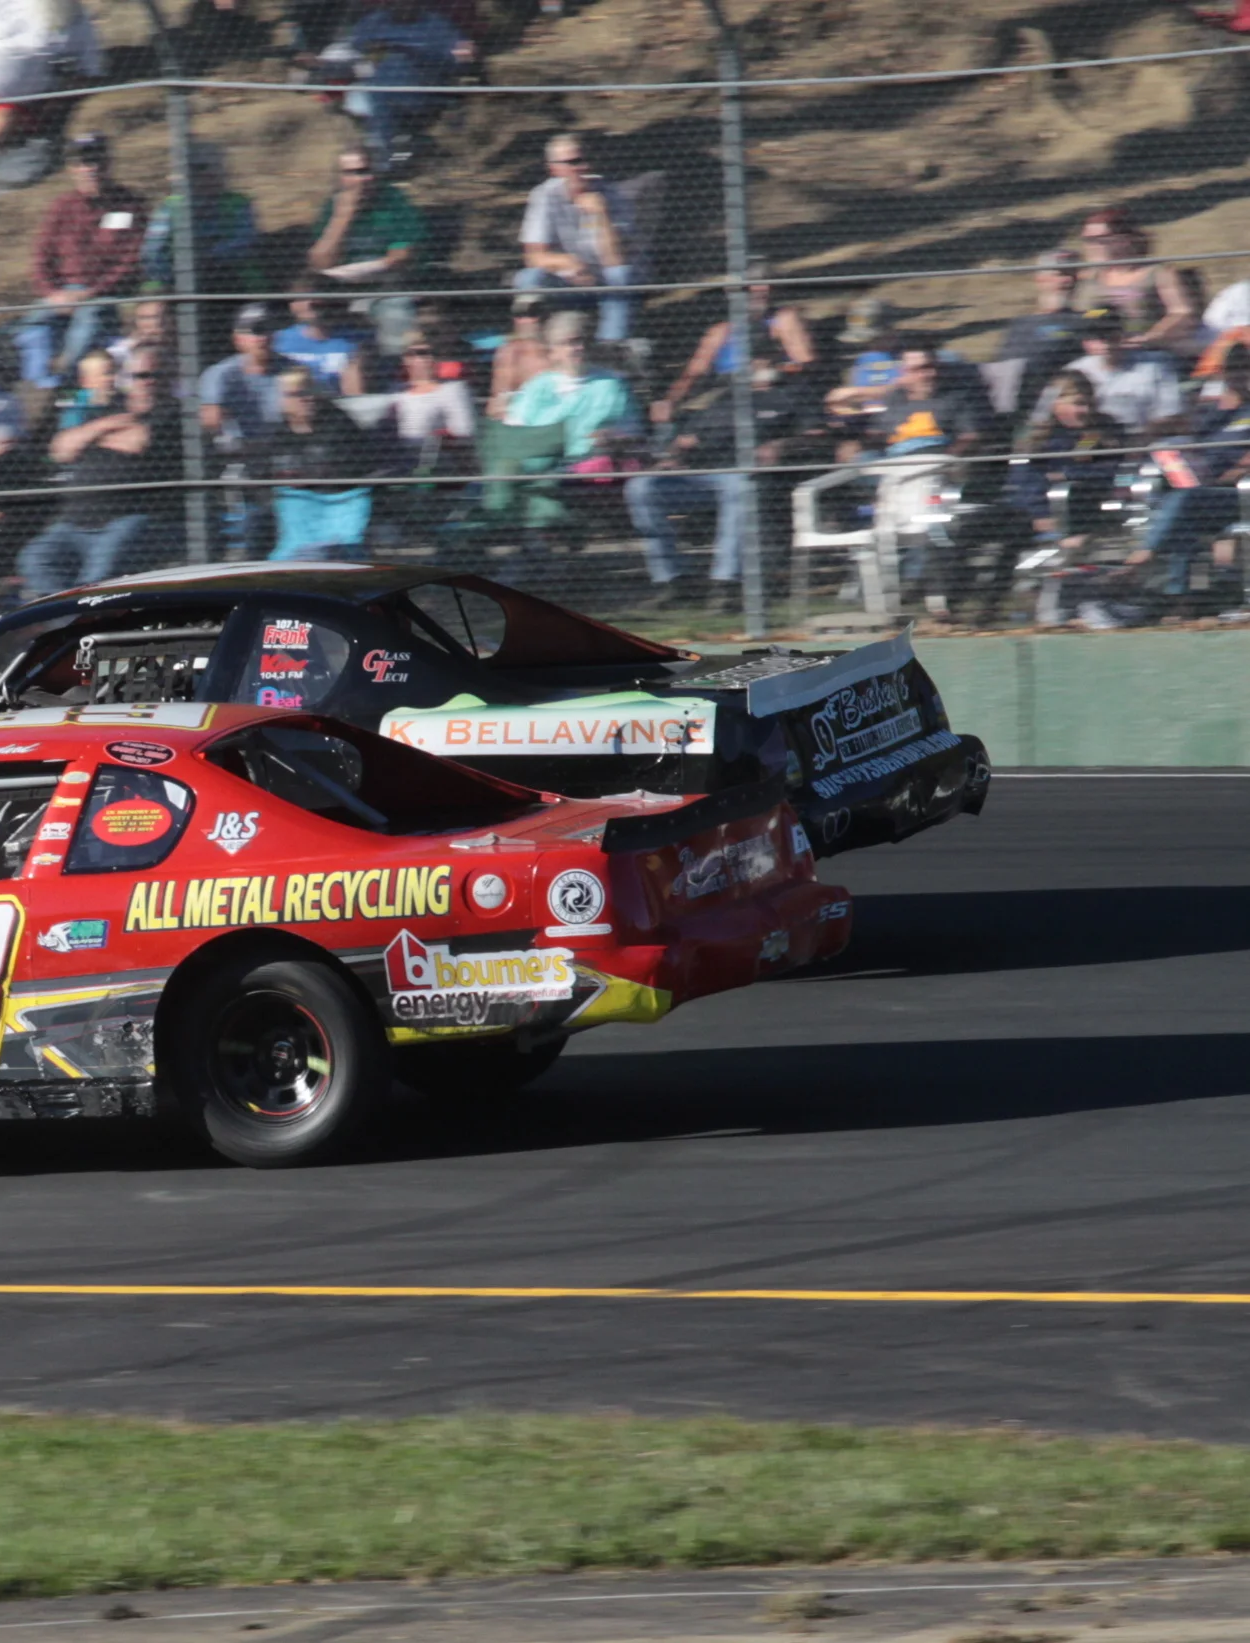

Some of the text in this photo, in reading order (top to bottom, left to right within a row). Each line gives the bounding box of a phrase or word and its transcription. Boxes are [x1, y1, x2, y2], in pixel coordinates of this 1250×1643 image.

[262, 624, 310, 646] Frank
[275, 619, 300, 630] 107.1
[287, 671, 304, 679] FM
[259, 688, 303, 709] Beat
[388, 717, 708, 746] K. BELLAVANCE
[206, 811, 260, 841] J&S
[124, 865, 452, 932] ALL METAL RECYCLING
[433, 953, 568, 989] bourne's
[394, 990, 489, 1021] energy
